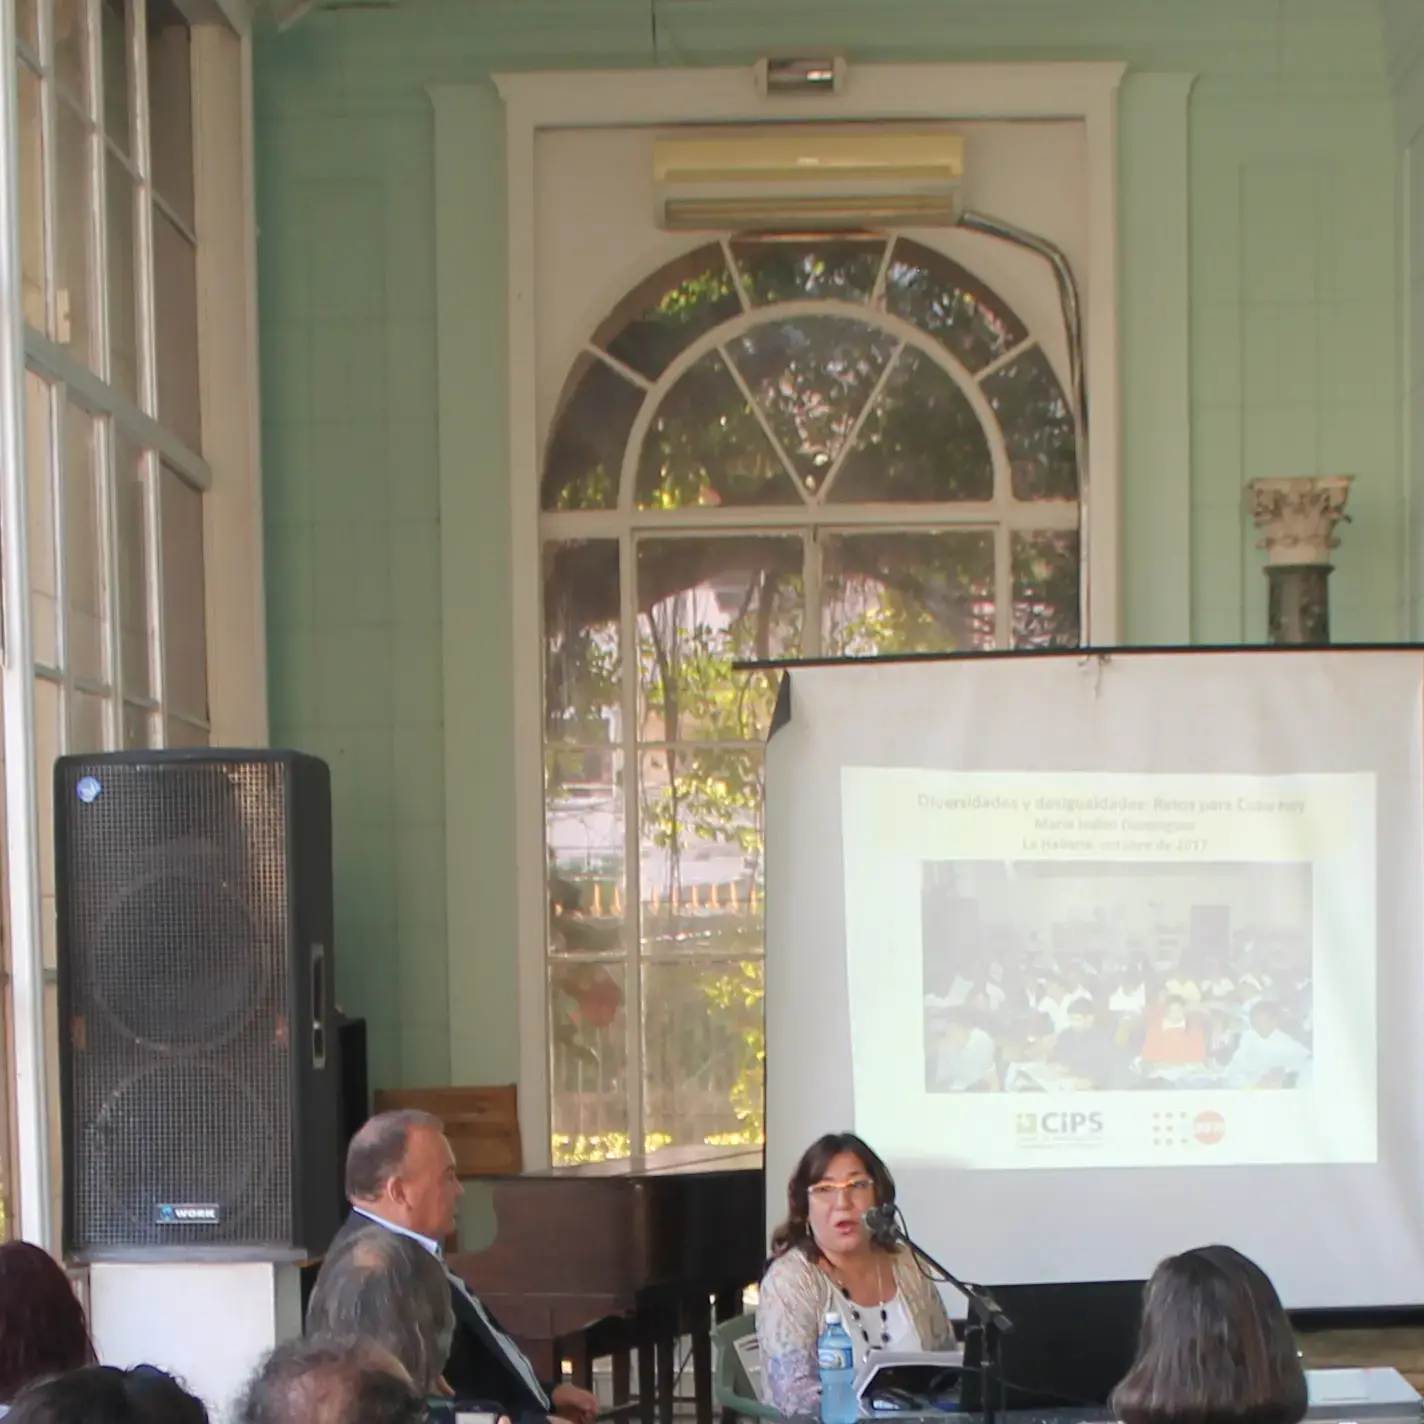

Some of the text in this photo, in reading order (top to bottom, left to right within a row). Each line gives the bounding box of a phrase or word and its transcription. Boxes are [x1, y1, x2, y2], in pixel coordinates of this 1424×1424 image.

[917, 793, 1018, 811] Diversidades
[1022, 797, 1032, 812] y
[1200, 799, 1232, 814] para
[174, 1208, 216, 1219] WORK
